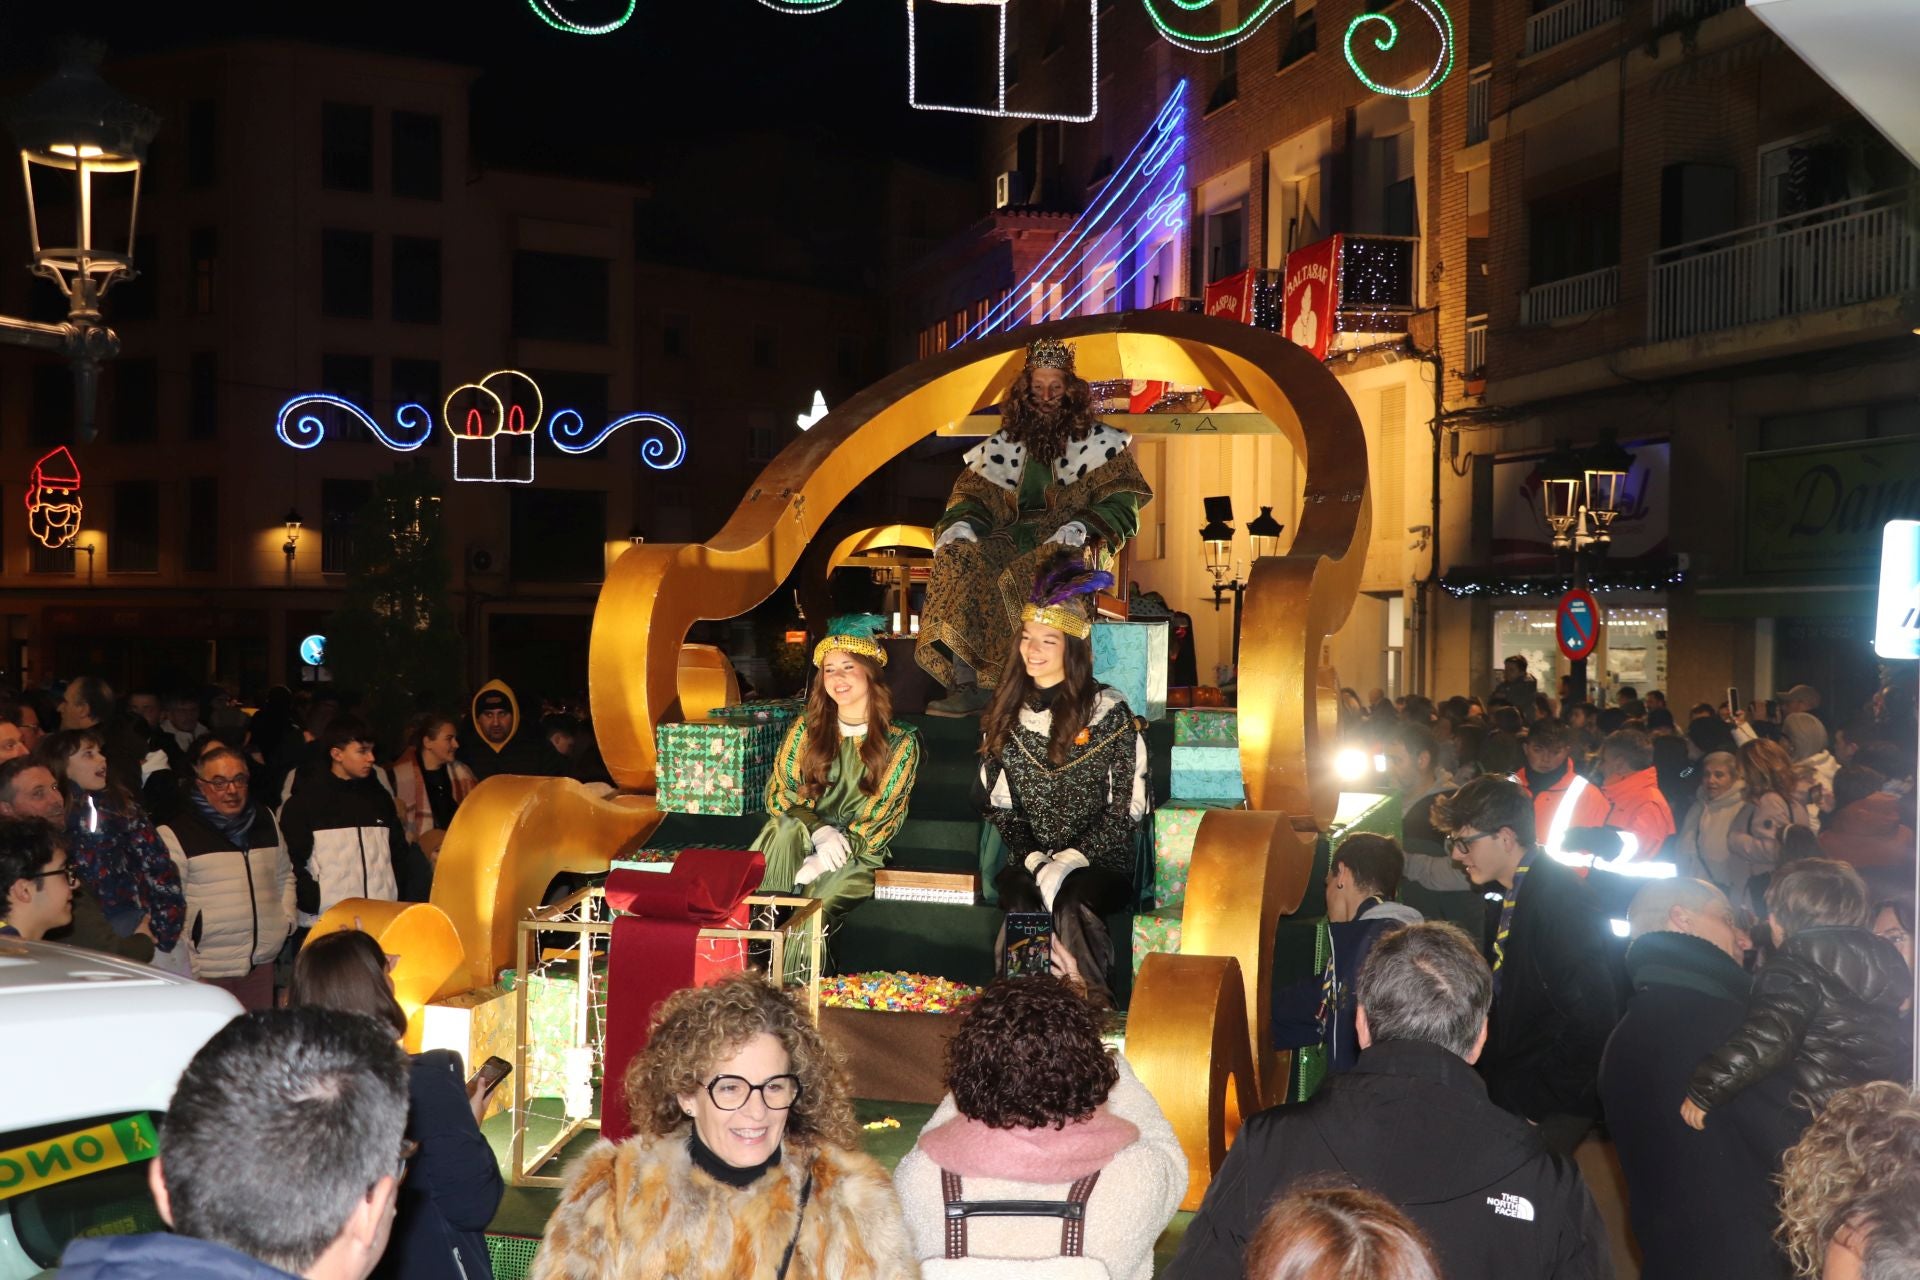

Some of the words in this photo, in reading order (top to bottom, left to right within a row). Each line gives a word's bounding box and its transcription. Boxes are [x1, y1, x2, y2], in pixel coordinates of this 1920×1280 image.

[1287, 263, 1329, 297] BALTASAR
[1486, 1196, 1519, 1211] NORTH
[1501, 1192, 1519, 1204] THE
[1494, 1206, 1518, 1218] FACE
